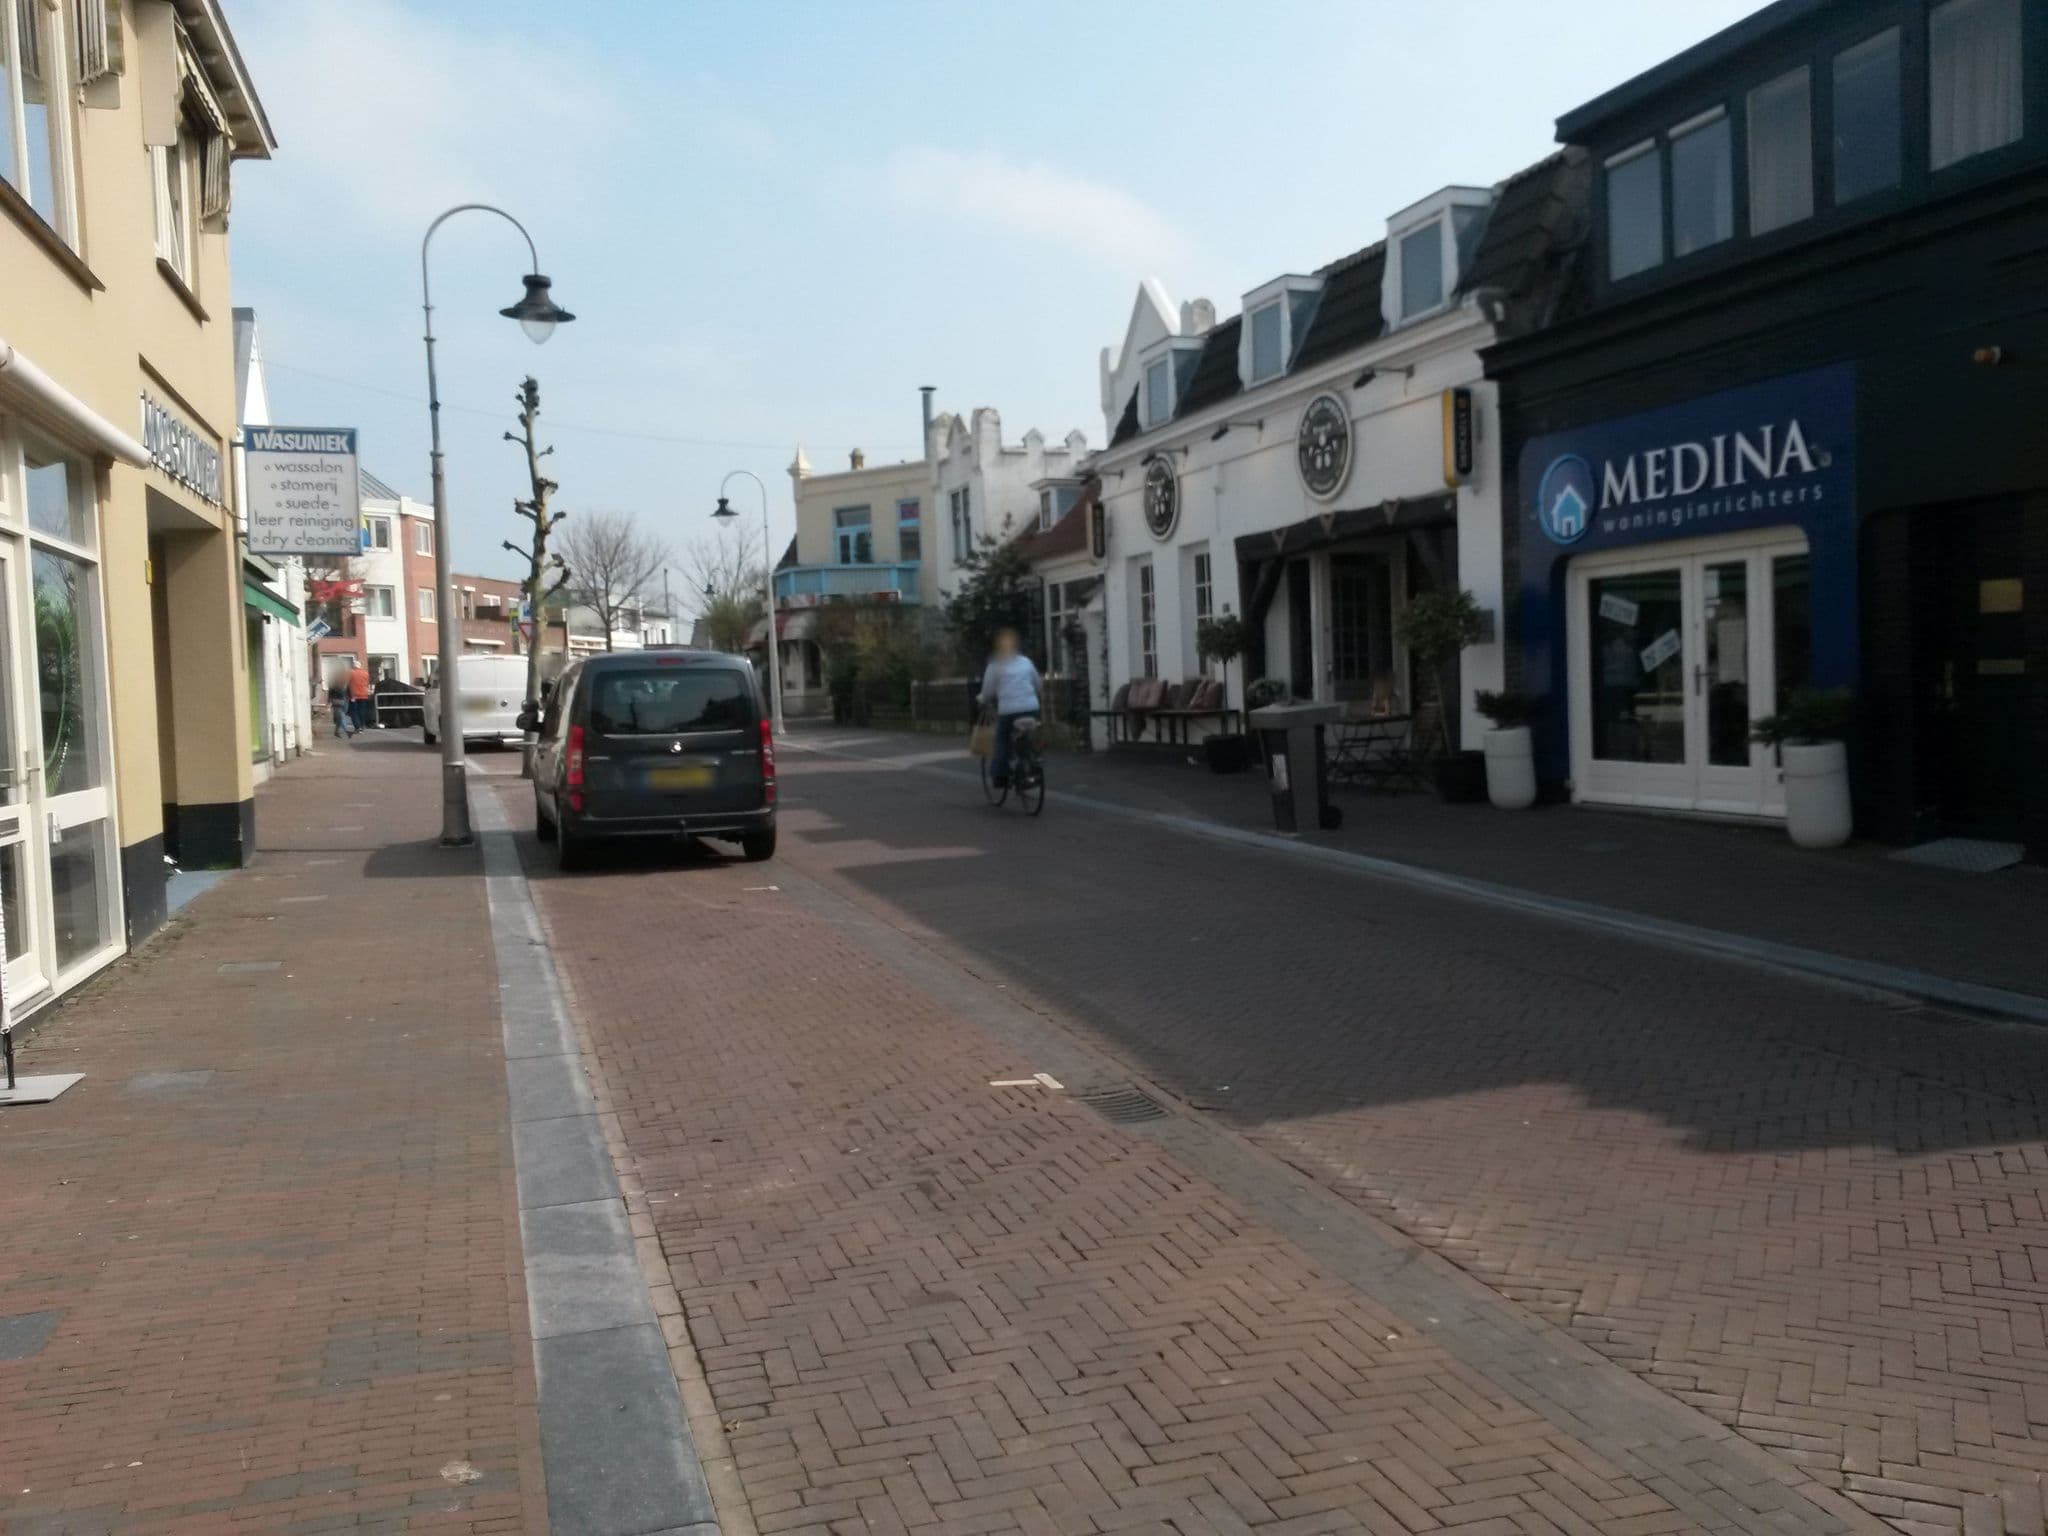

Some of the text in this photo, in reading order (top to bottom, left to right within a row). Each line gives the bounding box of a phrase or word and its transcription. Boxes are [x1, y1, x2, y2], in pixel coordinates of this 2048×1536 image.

[252, 430, 349, 452] WASUNIEK
[274, 457, 344, 473] wassalon
[1600, 418, 1817, 509] MEDINA
[279, 479, 338, 497] stomerij
[1602, 484, 1824, 533] woninginrichters
[253, 510, 354, 533] leer reiniging
[261, 530, 358, 550] dry cleaning
